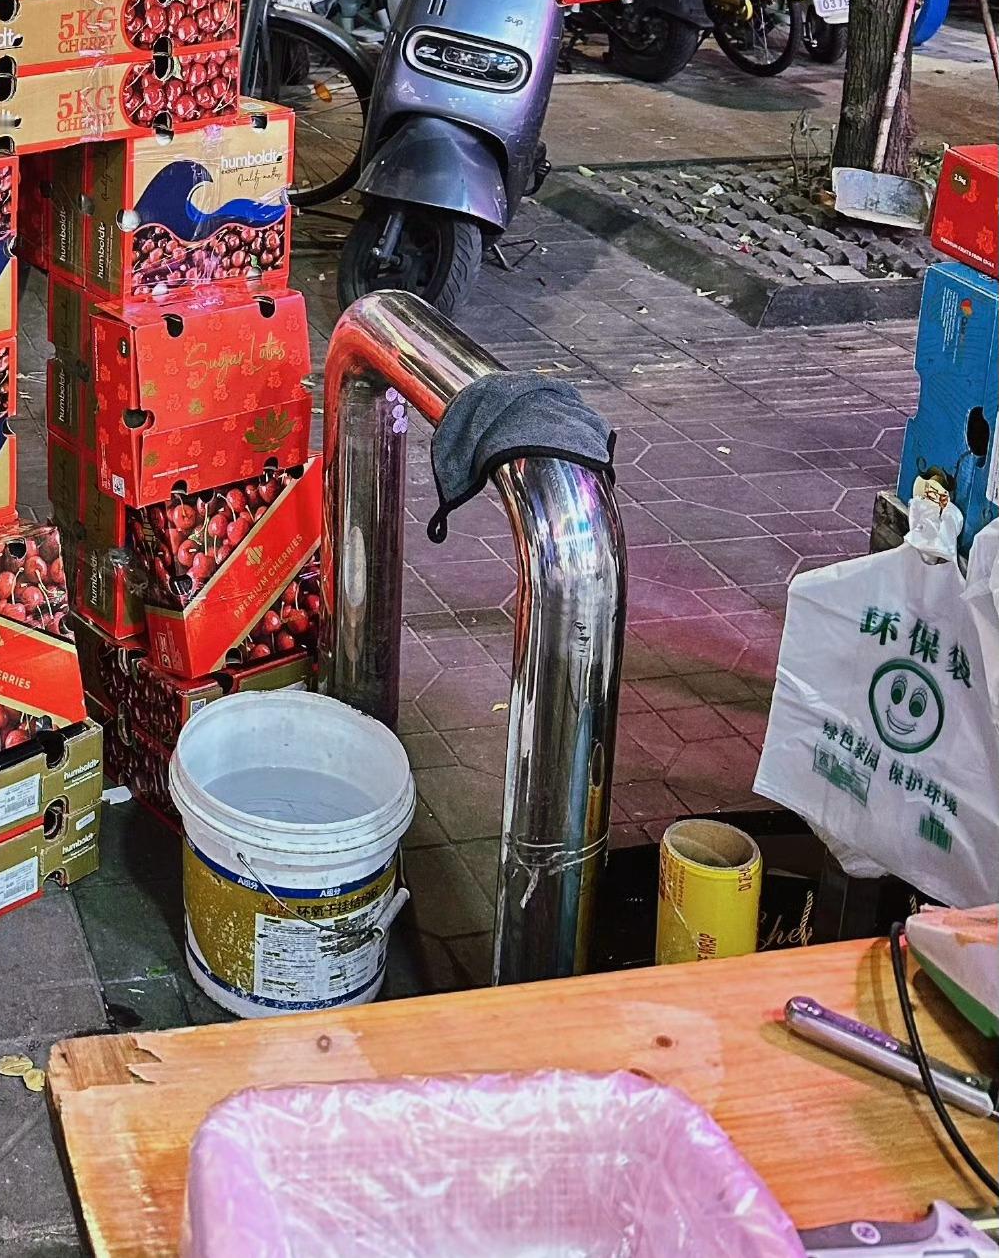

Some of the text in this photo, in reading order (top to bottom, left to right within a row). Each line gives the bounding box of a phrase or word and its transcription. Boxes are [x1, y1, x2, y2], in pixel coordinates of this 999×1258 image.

[58, 7, 117, 37] 5KG
[57, 85, 116, 117] 5KG
[221, 149, 283, 169] humboldt
[59, 206, 67, 262] humboldt
[96, 222, 105, 279] humboldt
[58, 368, 67, 423] humboldt
[233, 533, 304, 619] PREMIUM CHERRIES
[860, 605, 973, 688] 环保袋
[64, 759, 100, 781] humboldt
[889, 760, 959, 817] 保护环境
